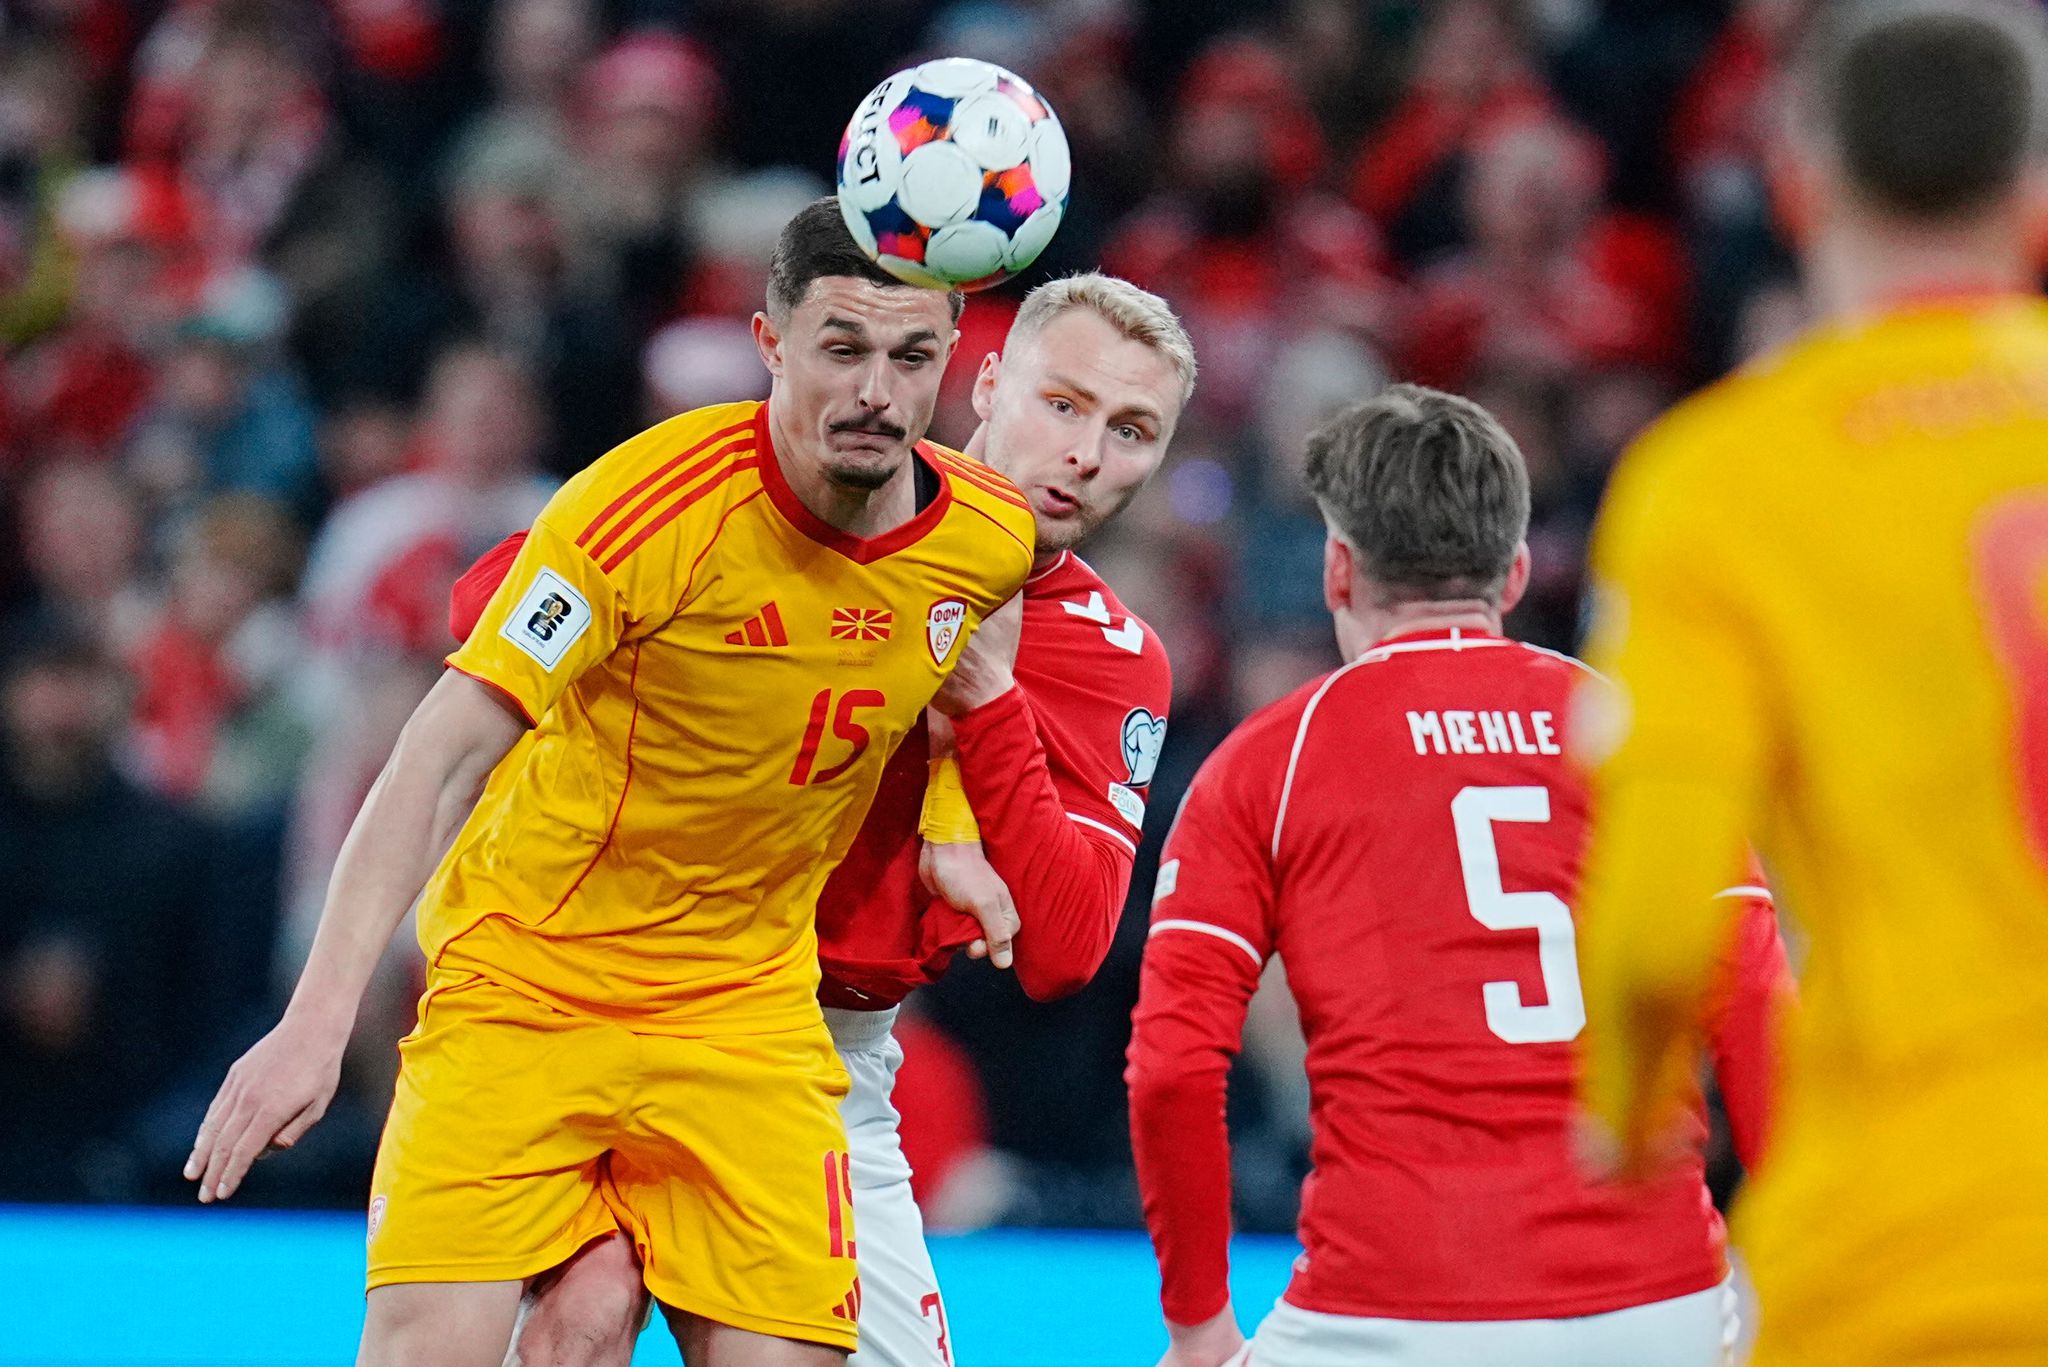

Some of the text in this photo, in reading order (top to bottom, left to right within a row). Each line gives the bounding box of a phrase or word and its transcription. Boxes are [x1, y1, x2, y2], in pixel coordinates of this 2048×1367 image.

[788, 688, 886, 786] 15
[1405, 710, 1561, 755] MÆHLE
[1450, 785, 1587, 1044] 5
